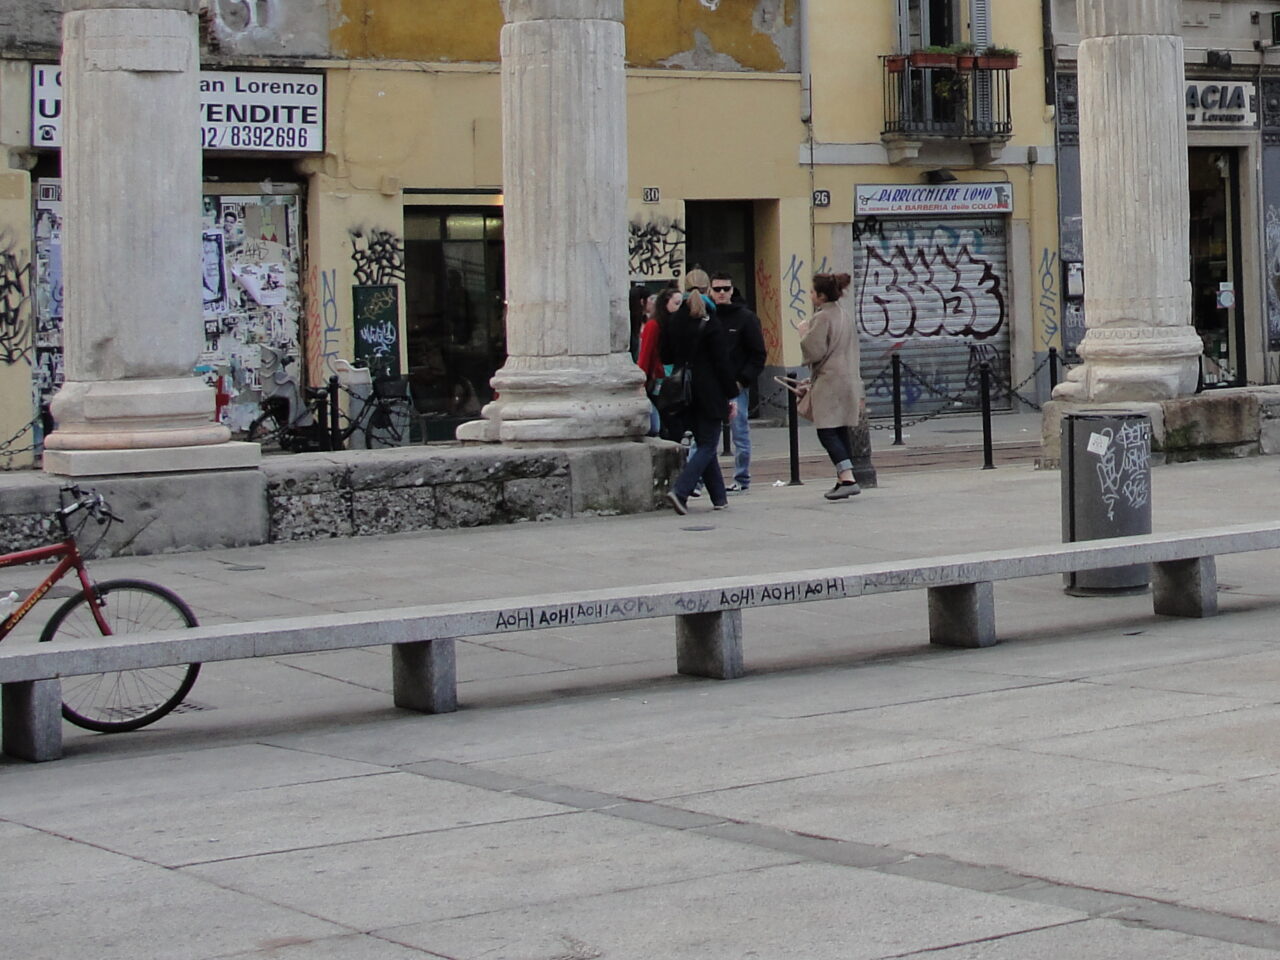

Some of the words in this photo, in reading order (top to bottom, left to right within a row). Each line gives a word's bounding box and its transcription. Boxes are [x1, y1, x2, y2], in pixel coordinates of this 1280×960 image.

[200, 78, 225, 93] an
[235, 76, 318, 96] Lorenzo
[1185, 84, 1246, 110] ACIA
[200, 102, 318, 125] ENDITE
[1202, 111, 1245, 123] Lorenzo
[644, 188, 659, 201] 30
[814, 191, 828, 205] 26
[878, 187, 961, 202] PARRUCCHIERE
[963, 187, 993, 201] UOMO
[905, 203, 948, 211] BARBERIA
